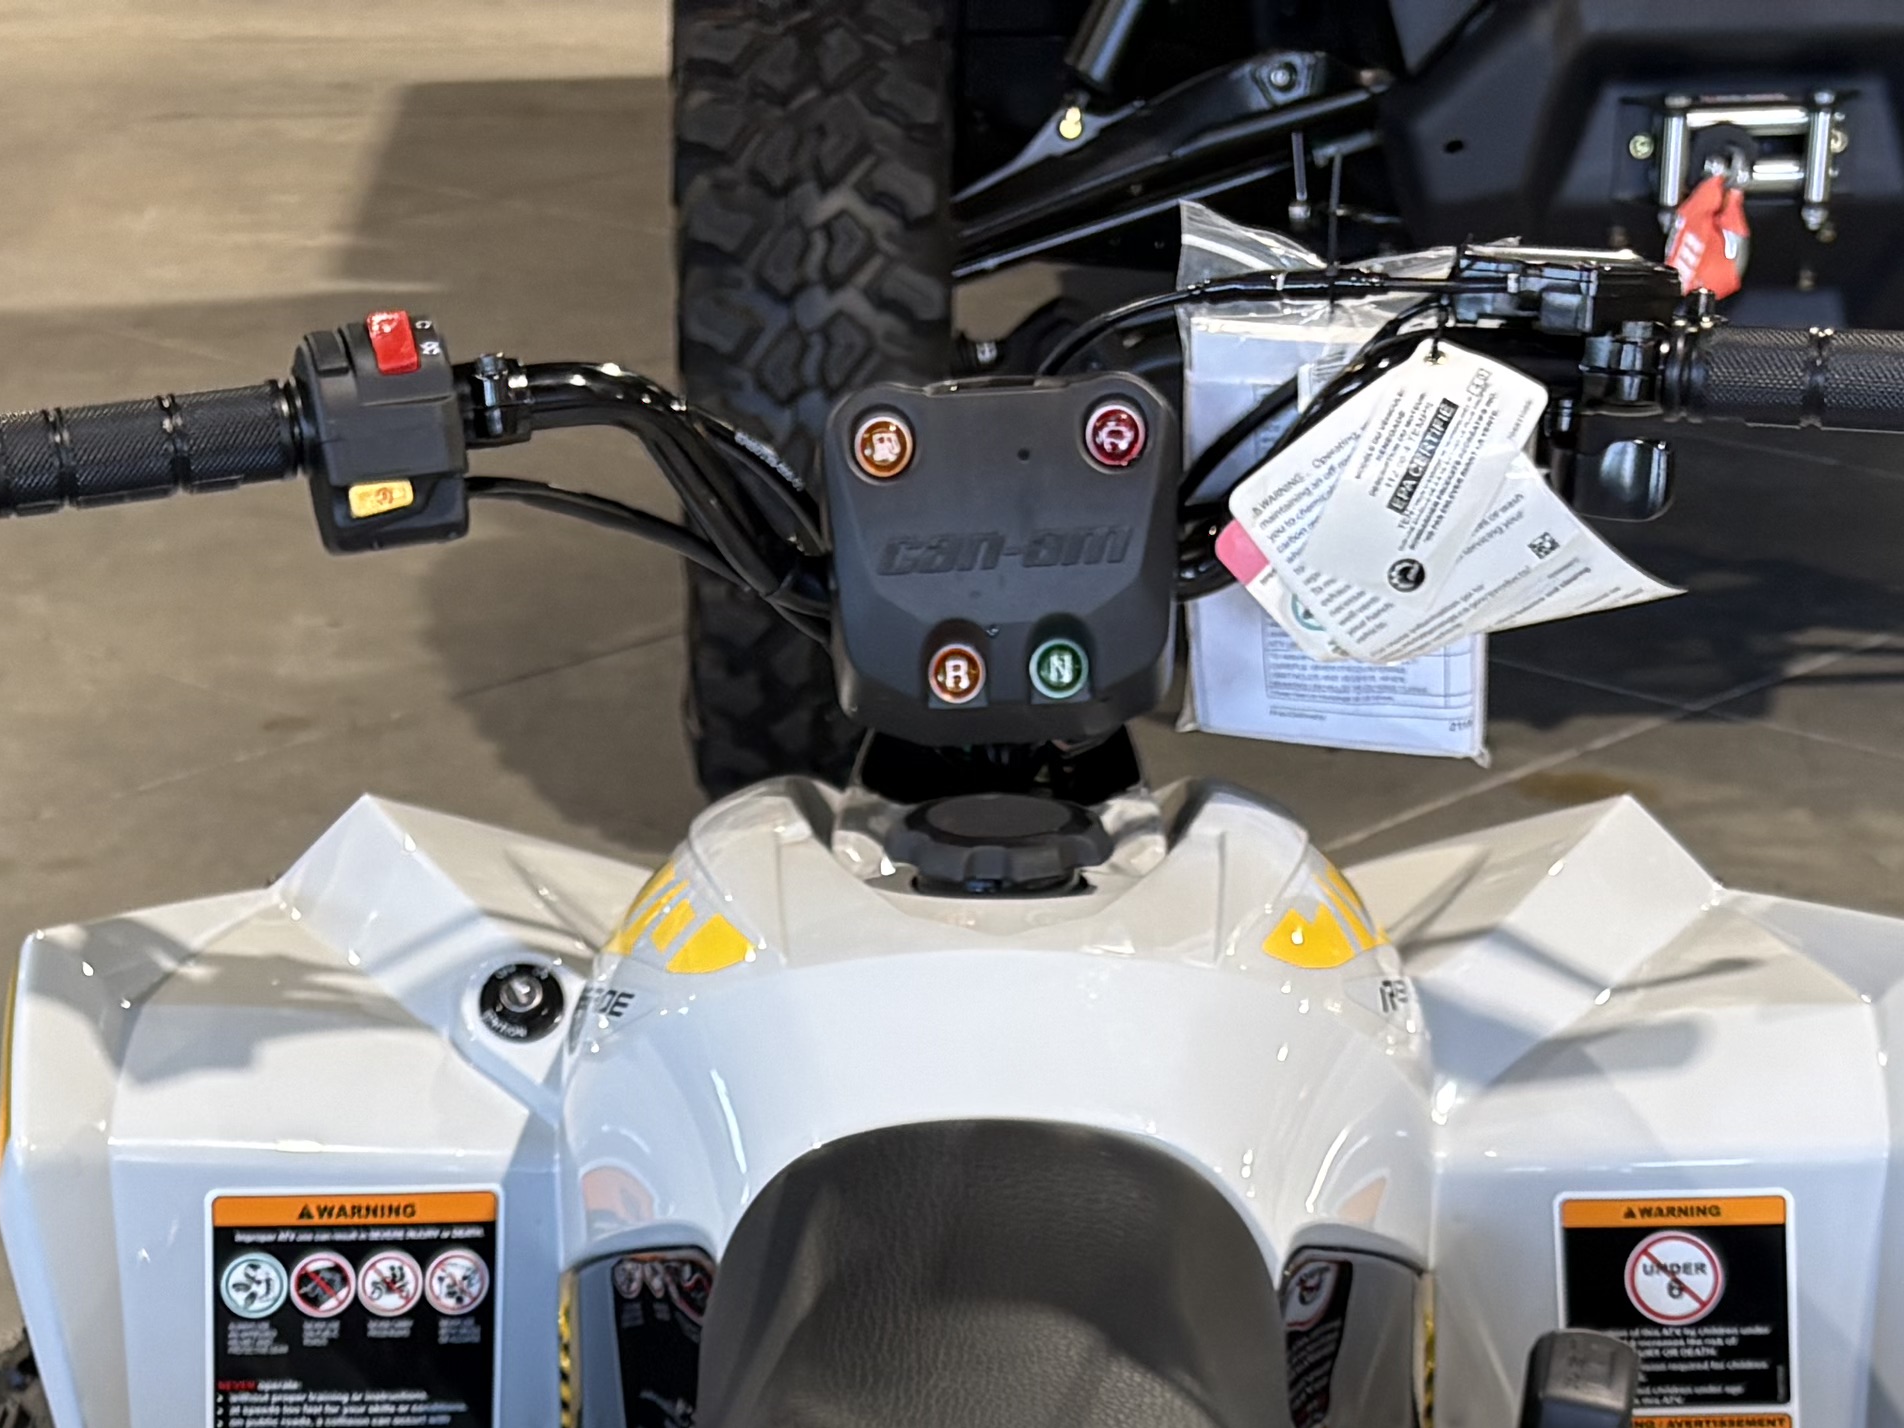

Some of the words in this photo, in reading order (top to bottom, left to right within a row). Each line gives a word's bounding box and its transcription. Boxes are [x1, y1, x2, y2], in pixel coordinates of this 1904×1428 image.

[1389, 475, 1418, 511] EPA
[1257, 486, 1313, 531] maintaining
[1266, 523, 1288, 543] you
[1283, 516, 1296, 528] to
[877, 526, 1133, 576] can-am
[945, 657, 969, 690] R
[1050, 653, 1073, 685] N
[317, 1203, 417, 1220] WARNING
[1638, 1205, 1722, 1218] WARNING
[1642, 1262, 1707, 1276] UNDER
[1668, 1279, 1683, 1299] 6
